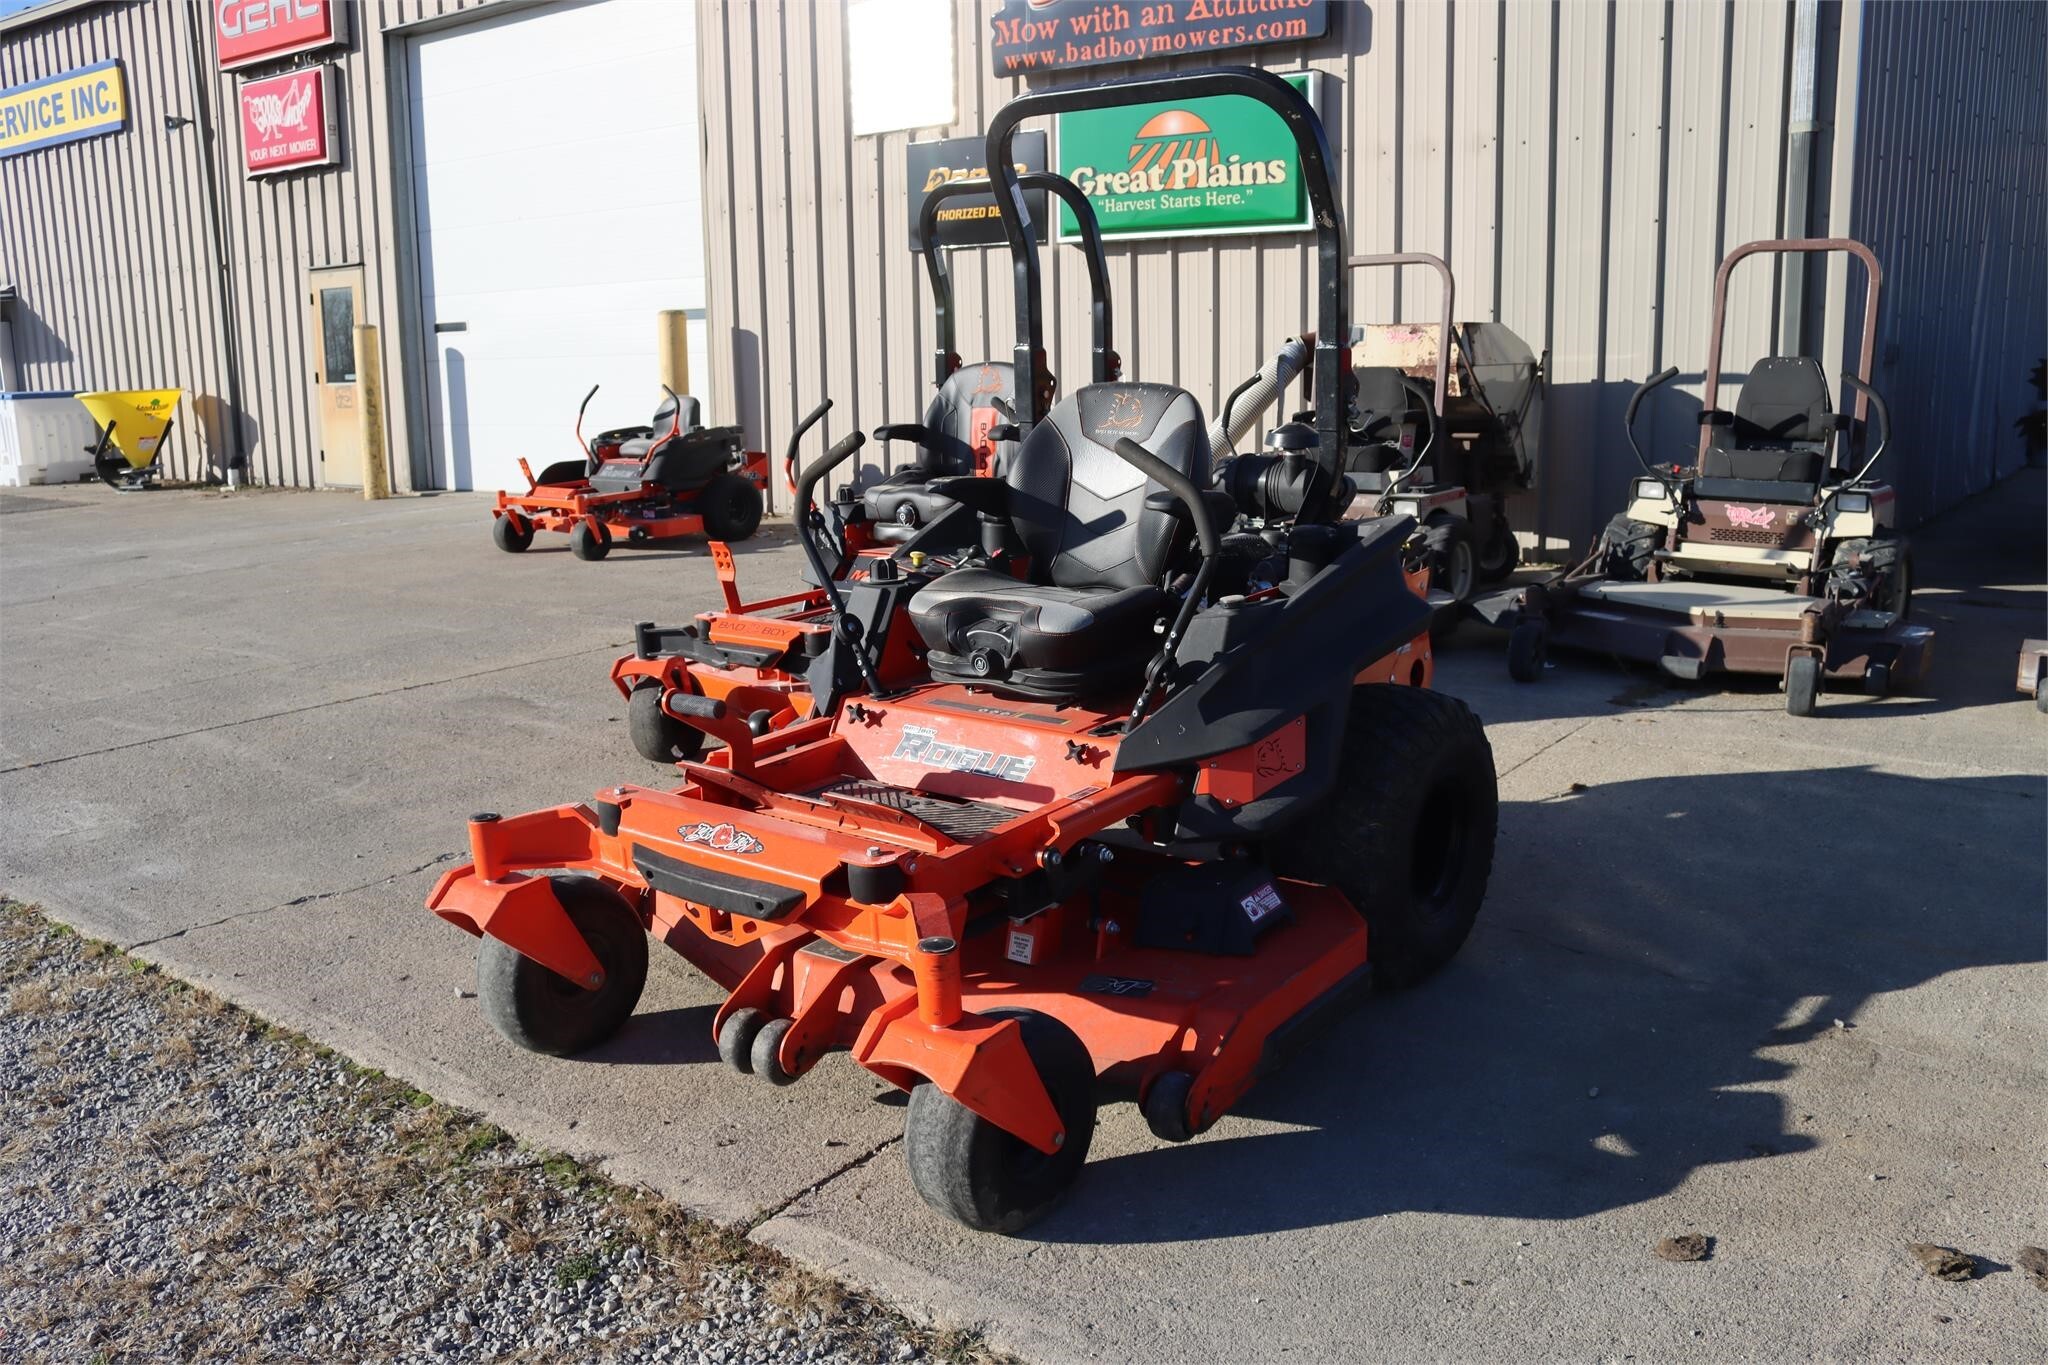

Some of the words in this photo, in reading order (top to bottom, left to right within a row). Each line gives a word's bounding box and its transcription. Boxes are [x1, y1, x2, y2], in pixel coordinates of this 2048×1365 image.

[994, 17, 1060, 47] Mow
[1070, 4, 1131, 35] with
[1140, 4, 1175, 27] an
[1004, 18, 1307, 70] www.badboymowers.com
[70, 80, 118, 121] INC.
[249, 146, 269, 161] YOUR
[269, 143, 288, 158] NEXT
[289, 138, 317, 154] MOWER
[1069, 164, 1166, 197] Great
[1171, 154, 1287, 190] Plains
[1160, 192, 1201, 208] Starts
[718, 621, 746, 631] BAD
[761, 626, 790, 636] BOY
[891, 732, 1036, 782] ROGUE
